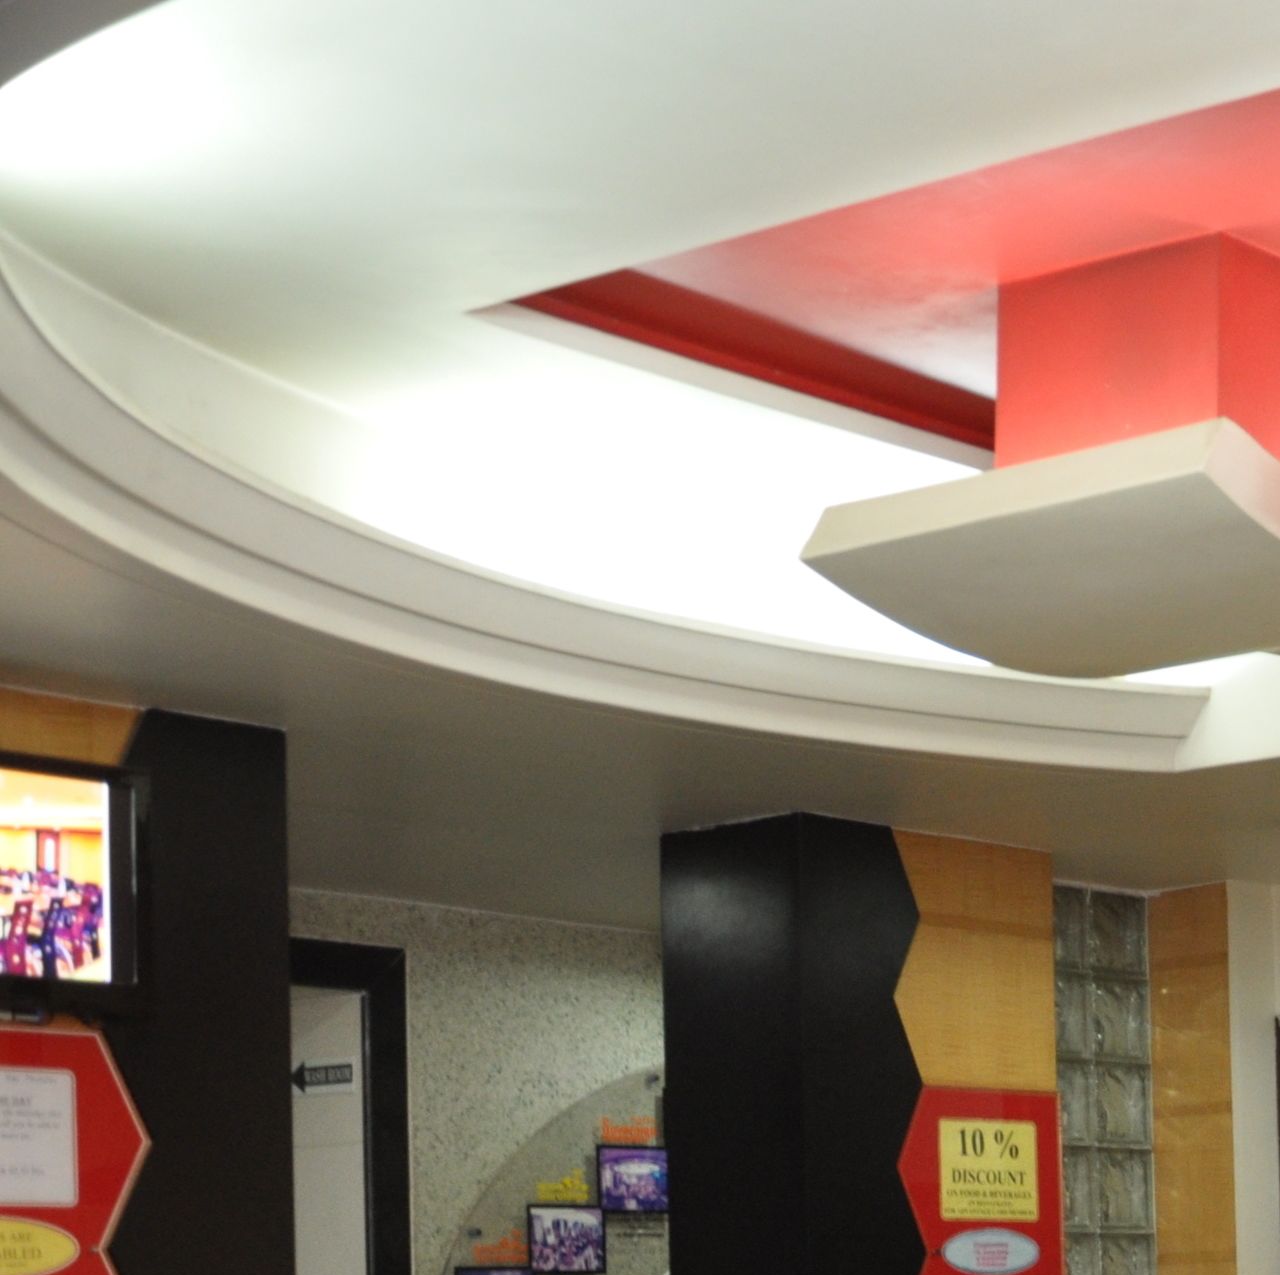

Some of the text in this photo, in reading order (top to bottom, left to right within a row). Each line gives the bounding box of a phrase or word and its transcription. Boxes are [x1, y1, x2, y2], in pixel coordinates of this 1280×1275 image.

[960, 1128, 1019, 1159] 10 %
[952, 1168, 1026, 1186] DISCOUNT
